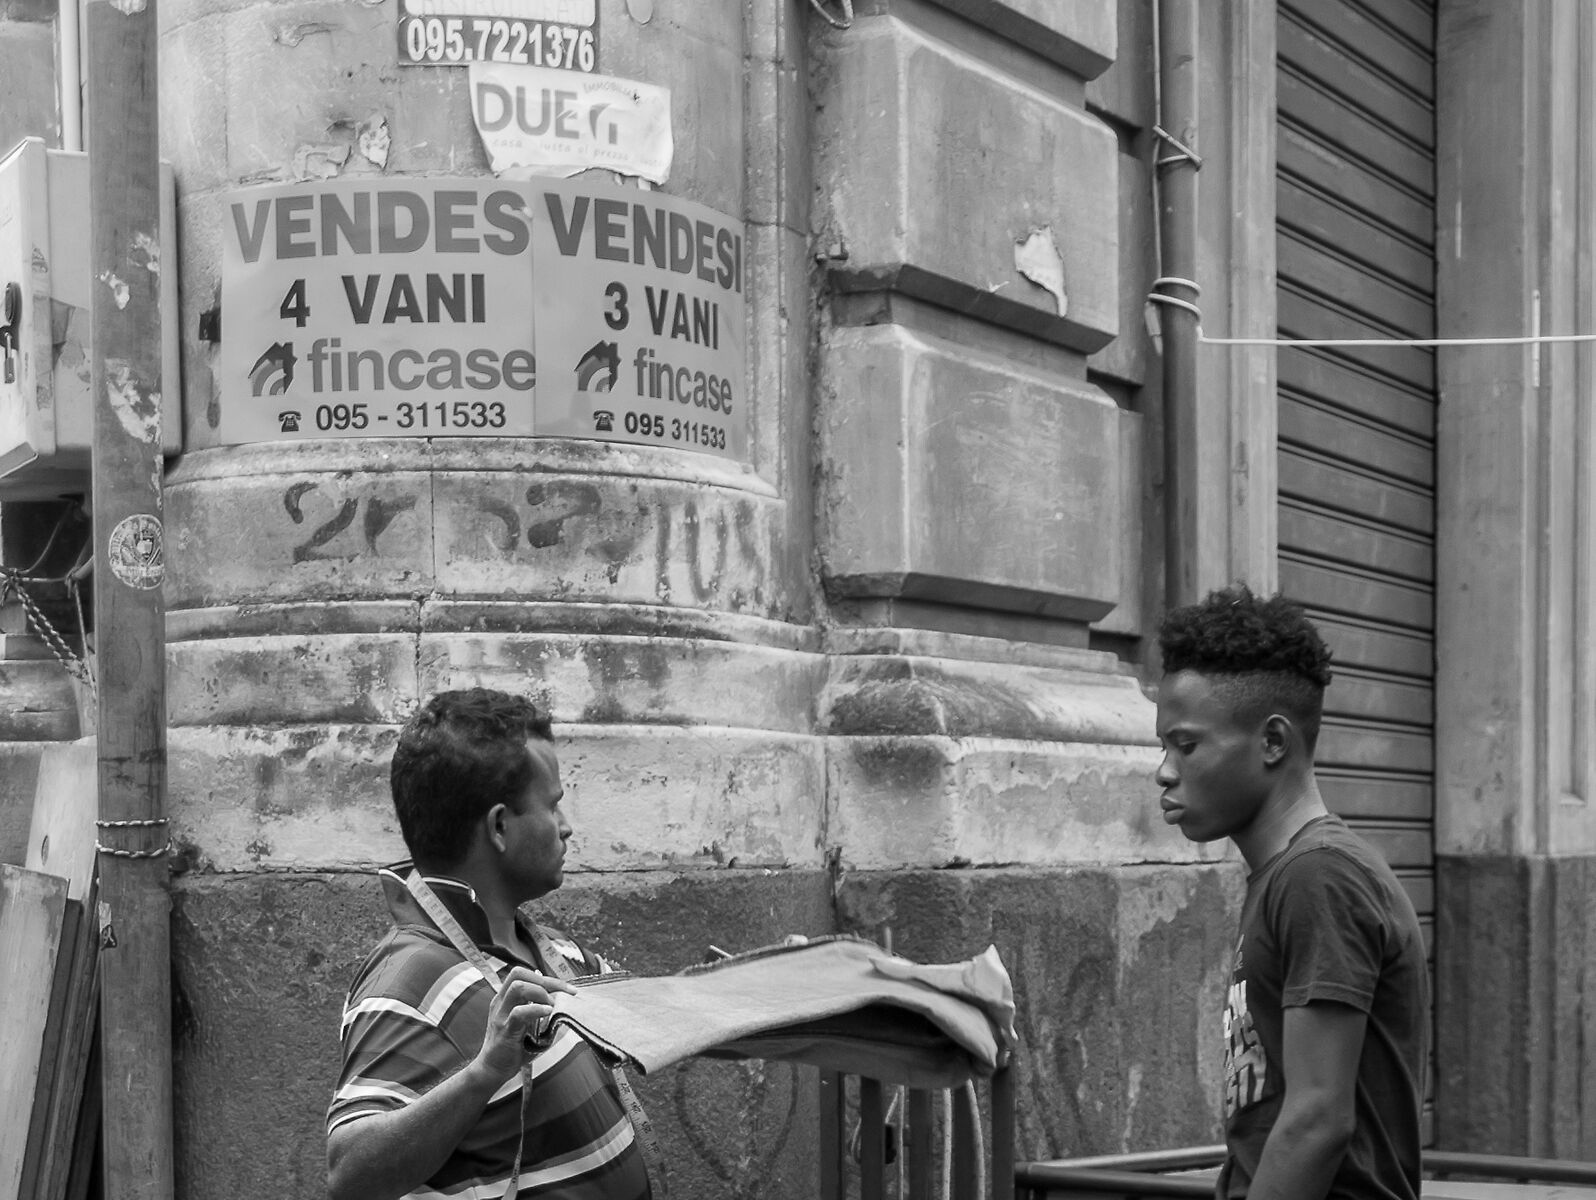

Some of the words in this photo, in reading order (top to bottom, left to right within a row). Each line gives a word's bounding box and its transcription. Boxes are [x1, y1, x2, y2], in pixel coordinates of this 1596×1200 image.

[407, 18, 594, 73] 095.7221376
[476, 82, 580, 140] DUE
[230, 189, 530, 263] VENDES
[544, 192, 742, 294] VENDESI
[280, 279, 311, 328] 4
[341, 272, 486, 324] VANI
[604, 281, 629, 331] 3
[644, 285, 719, 350] VANI
[307, 337, 536, 393] fincase
[633, 346, 732, 416] fincase
[316, 403, 369, 431] 095
[396, 401, 507, 429] 311533
[624, 411, 665, 437] 095
[671, 418, 727, 450] 311533
